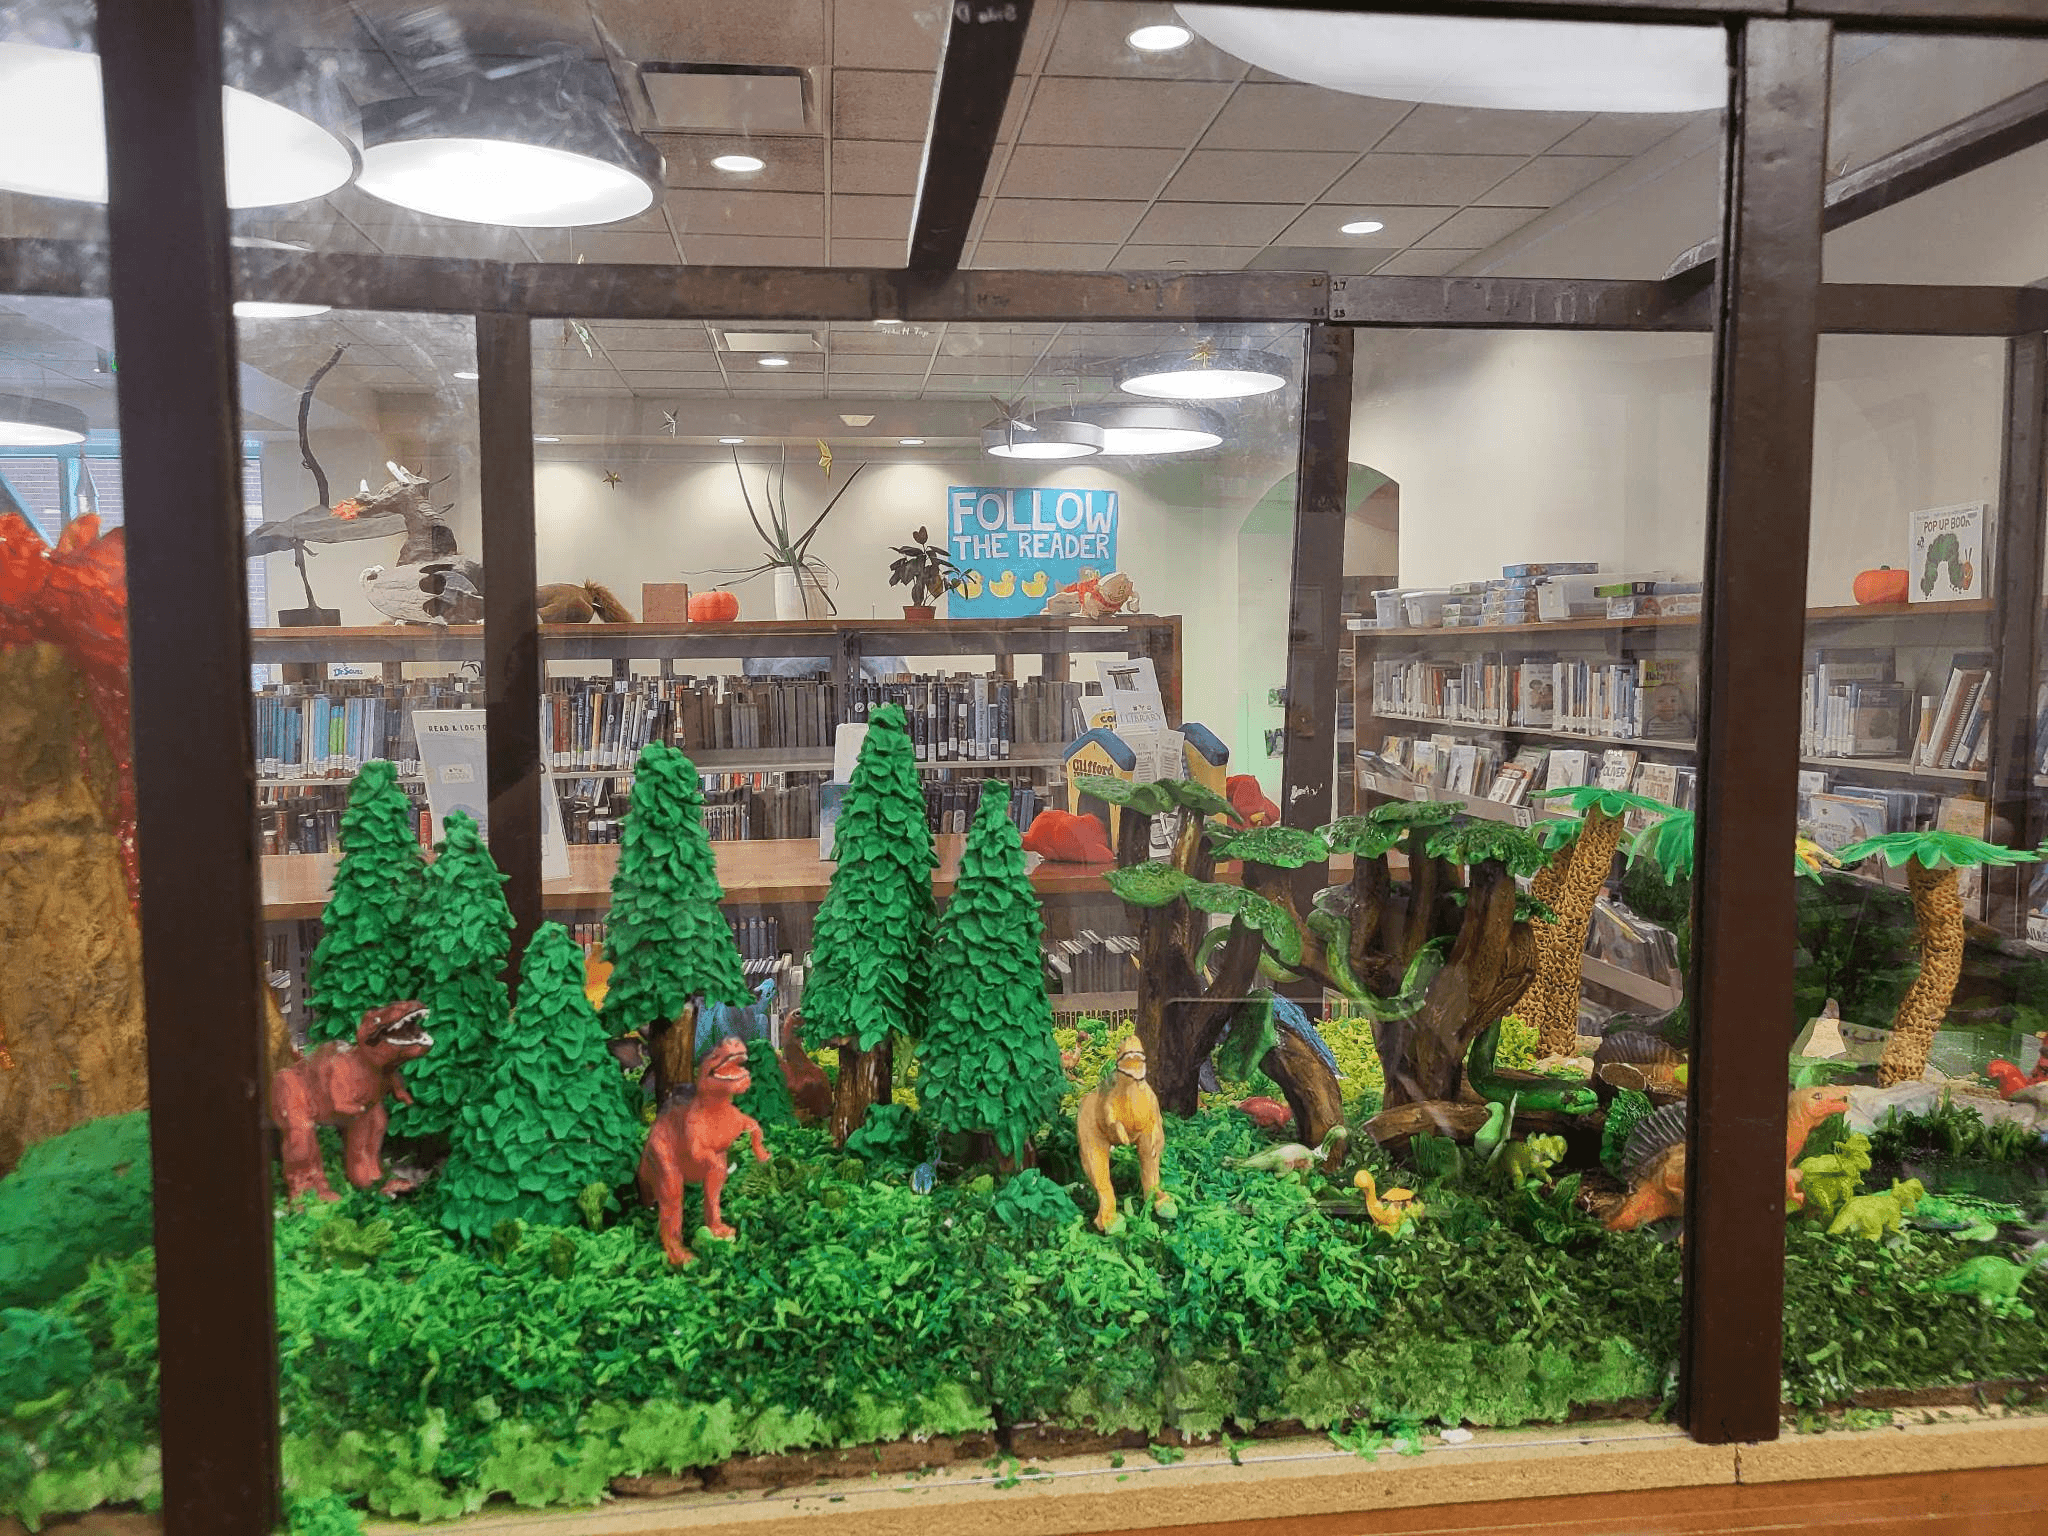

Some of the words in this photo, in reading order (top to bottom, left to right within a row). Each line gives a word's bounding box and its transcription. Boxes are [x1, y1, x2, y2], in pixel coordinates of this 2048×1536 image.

[1334, 281, 1346, 291] 17
[952, 490, 1115, 535] FOLLOW
[1924, 520, 1938, 532] POP
[1939, 518, 1950, 530] UP
[952, 533, 1010, 560] THE
[1018, 532, 1110, 560] READER
[1072, 758, 1115, 776] Clifford
